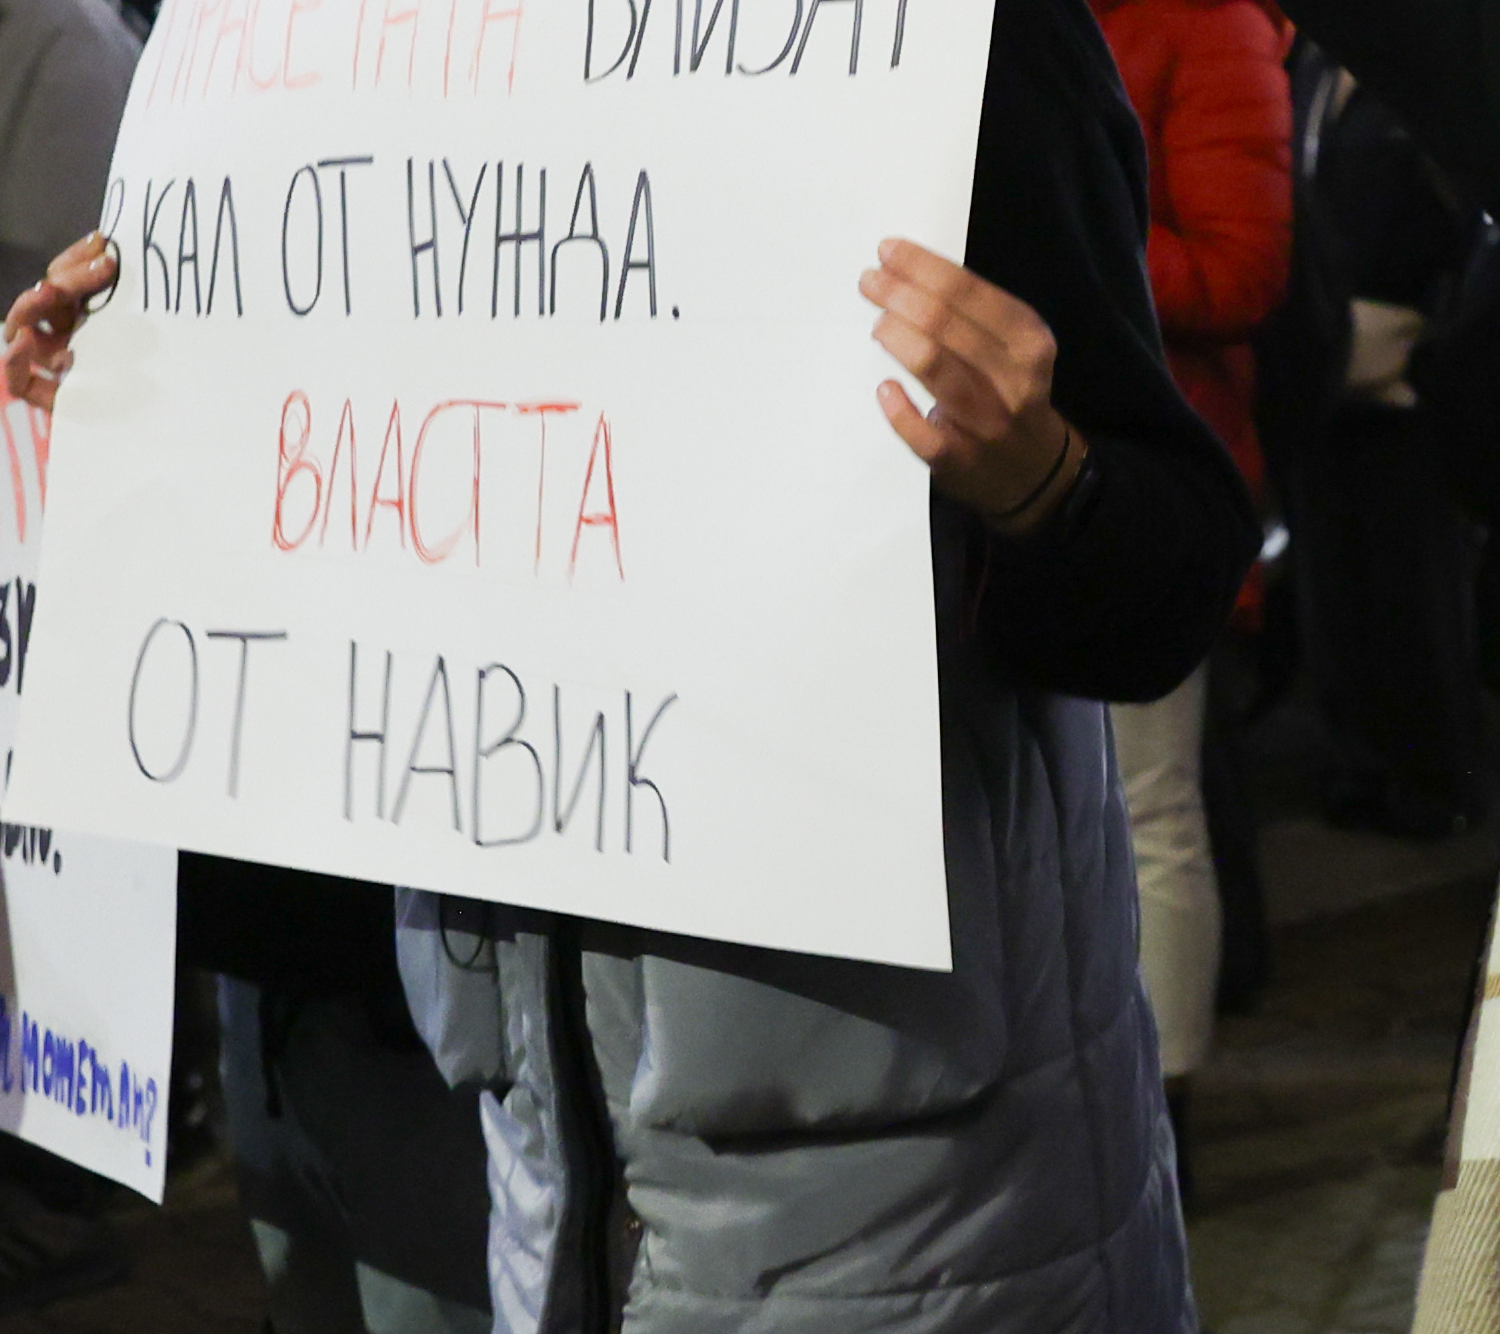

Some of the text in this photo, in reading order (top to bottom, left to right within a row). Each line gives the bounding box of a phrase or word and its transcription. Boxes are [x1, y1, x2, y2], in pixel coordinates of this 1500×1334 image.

[143, 174, 243, 318] КАЛ
[282, 154, 375, 319] ОТ
[406, 155, 681, 322] НУЖДА.
[271, 388, 625, 585] ВЛАСТТА
[128, 616, 679, 865] ОТ НАВИК
